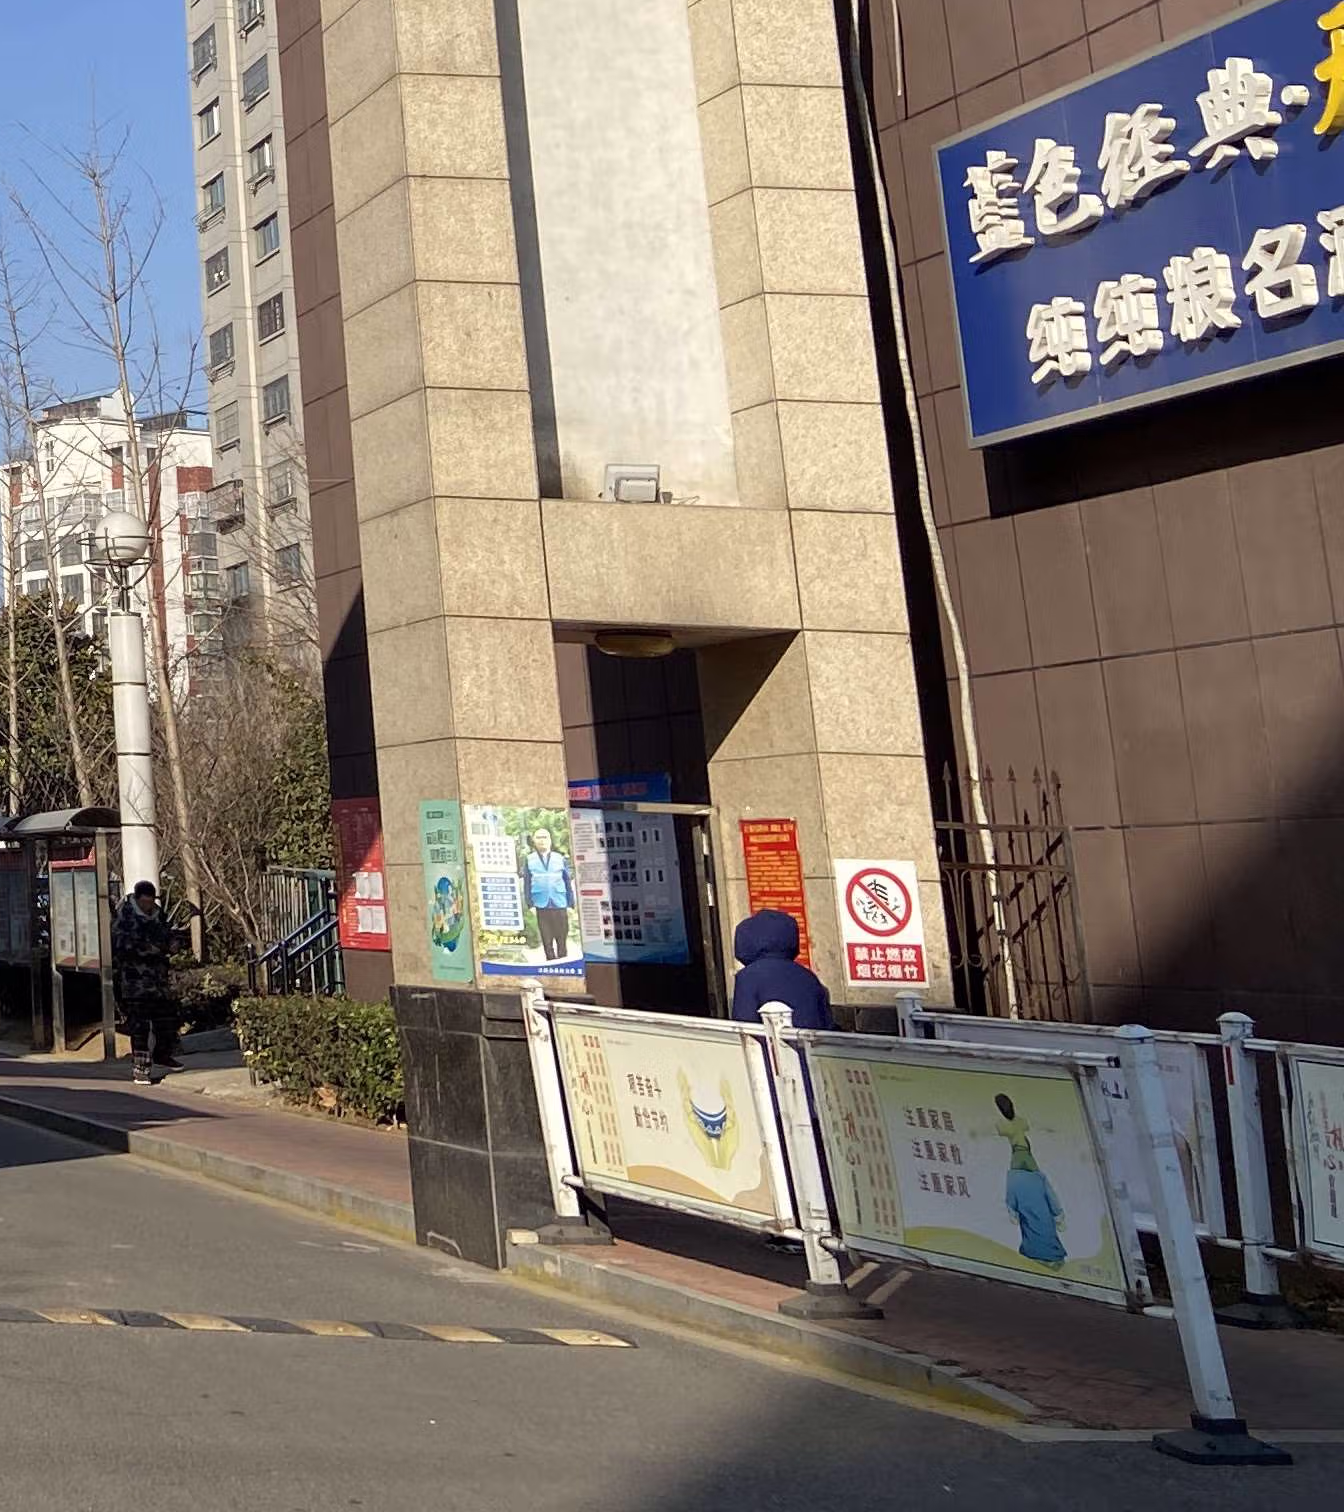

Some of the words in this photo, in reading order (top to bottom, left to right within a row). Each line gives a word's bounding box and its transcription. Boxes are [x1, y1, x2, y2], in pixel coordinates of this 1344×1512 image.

[854, 946, 916, 963] 禁止燃放
[855, 963, 919, 980] 烟花爆竹
[903, 1105, 957, 1133] 注重家庭
[911, 1138, 964, 1166] 注重家教
[918, 1170, 972, 1199] 注重家风
